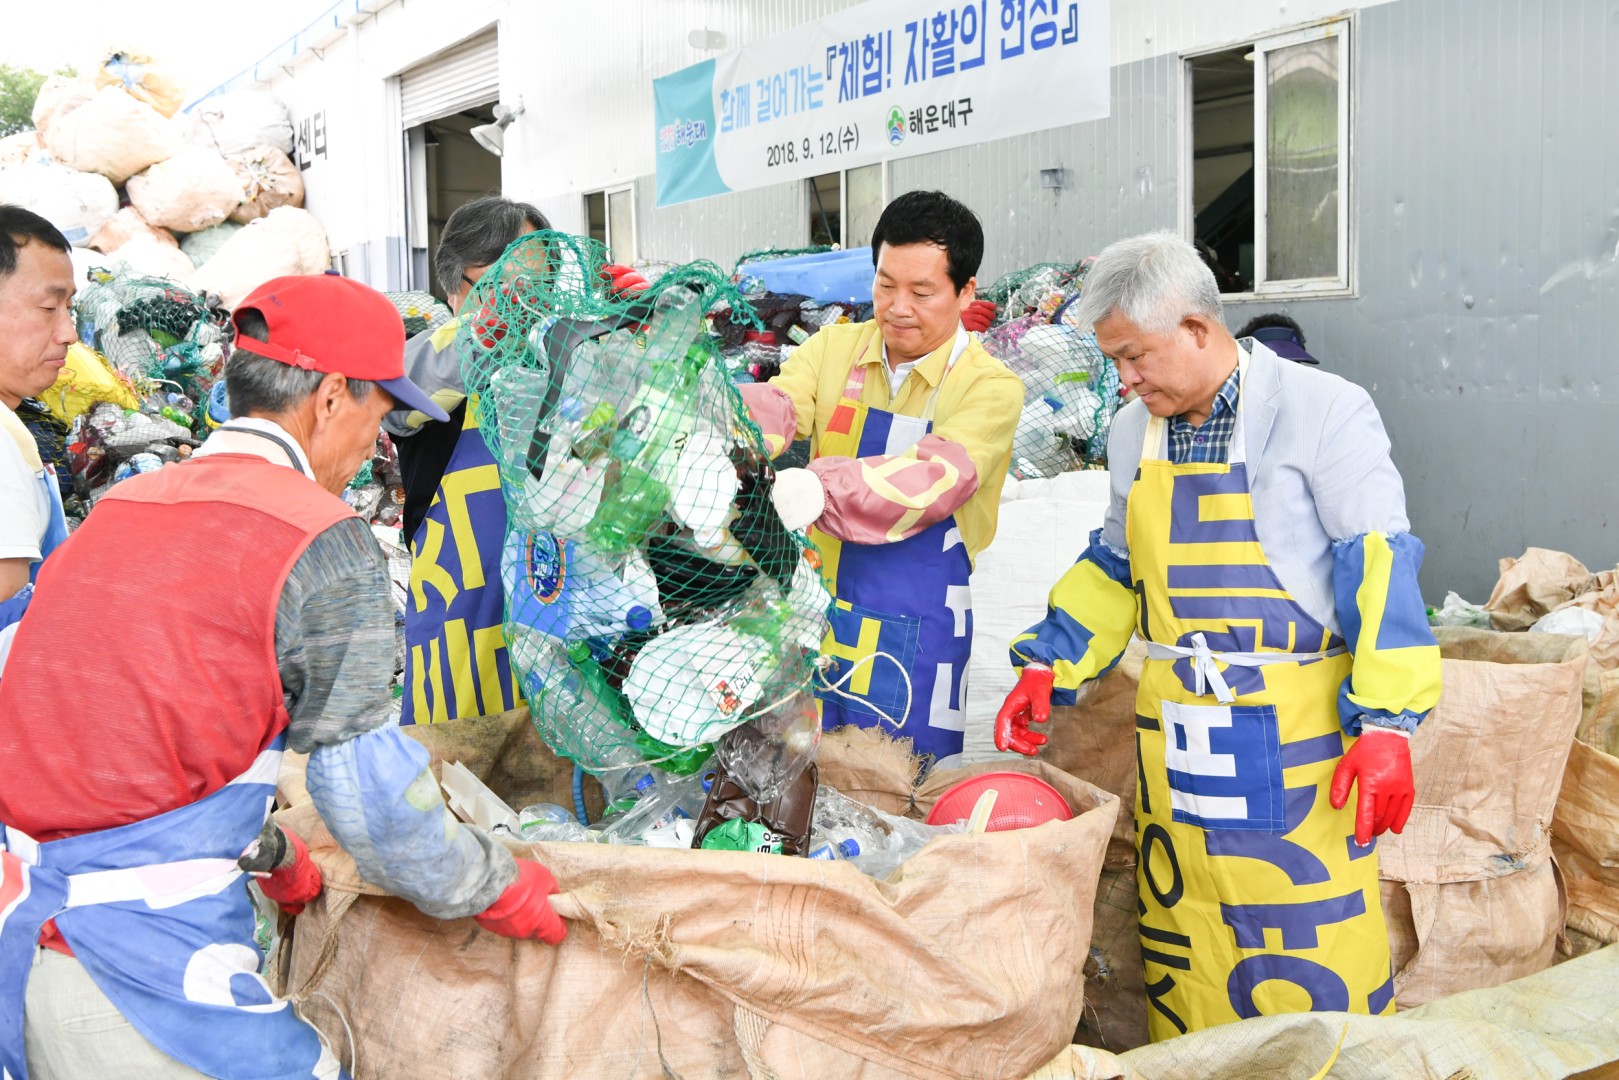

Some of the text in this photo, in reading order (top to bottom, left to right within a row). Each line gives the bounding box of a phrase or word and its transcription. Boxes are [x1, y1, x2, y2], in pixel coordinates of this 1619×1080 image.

[720, 83, 750, 132] 함께
[757, 64, 824, 123] 걸어가는
[904, 0, 987, 85] 자활의
[294, 109, 327, 172] 센터
[909, 97, 973, 135] 해운대구
[767, 141, 798, 167] 2018.
[803, 137, 814, 159] 9.
